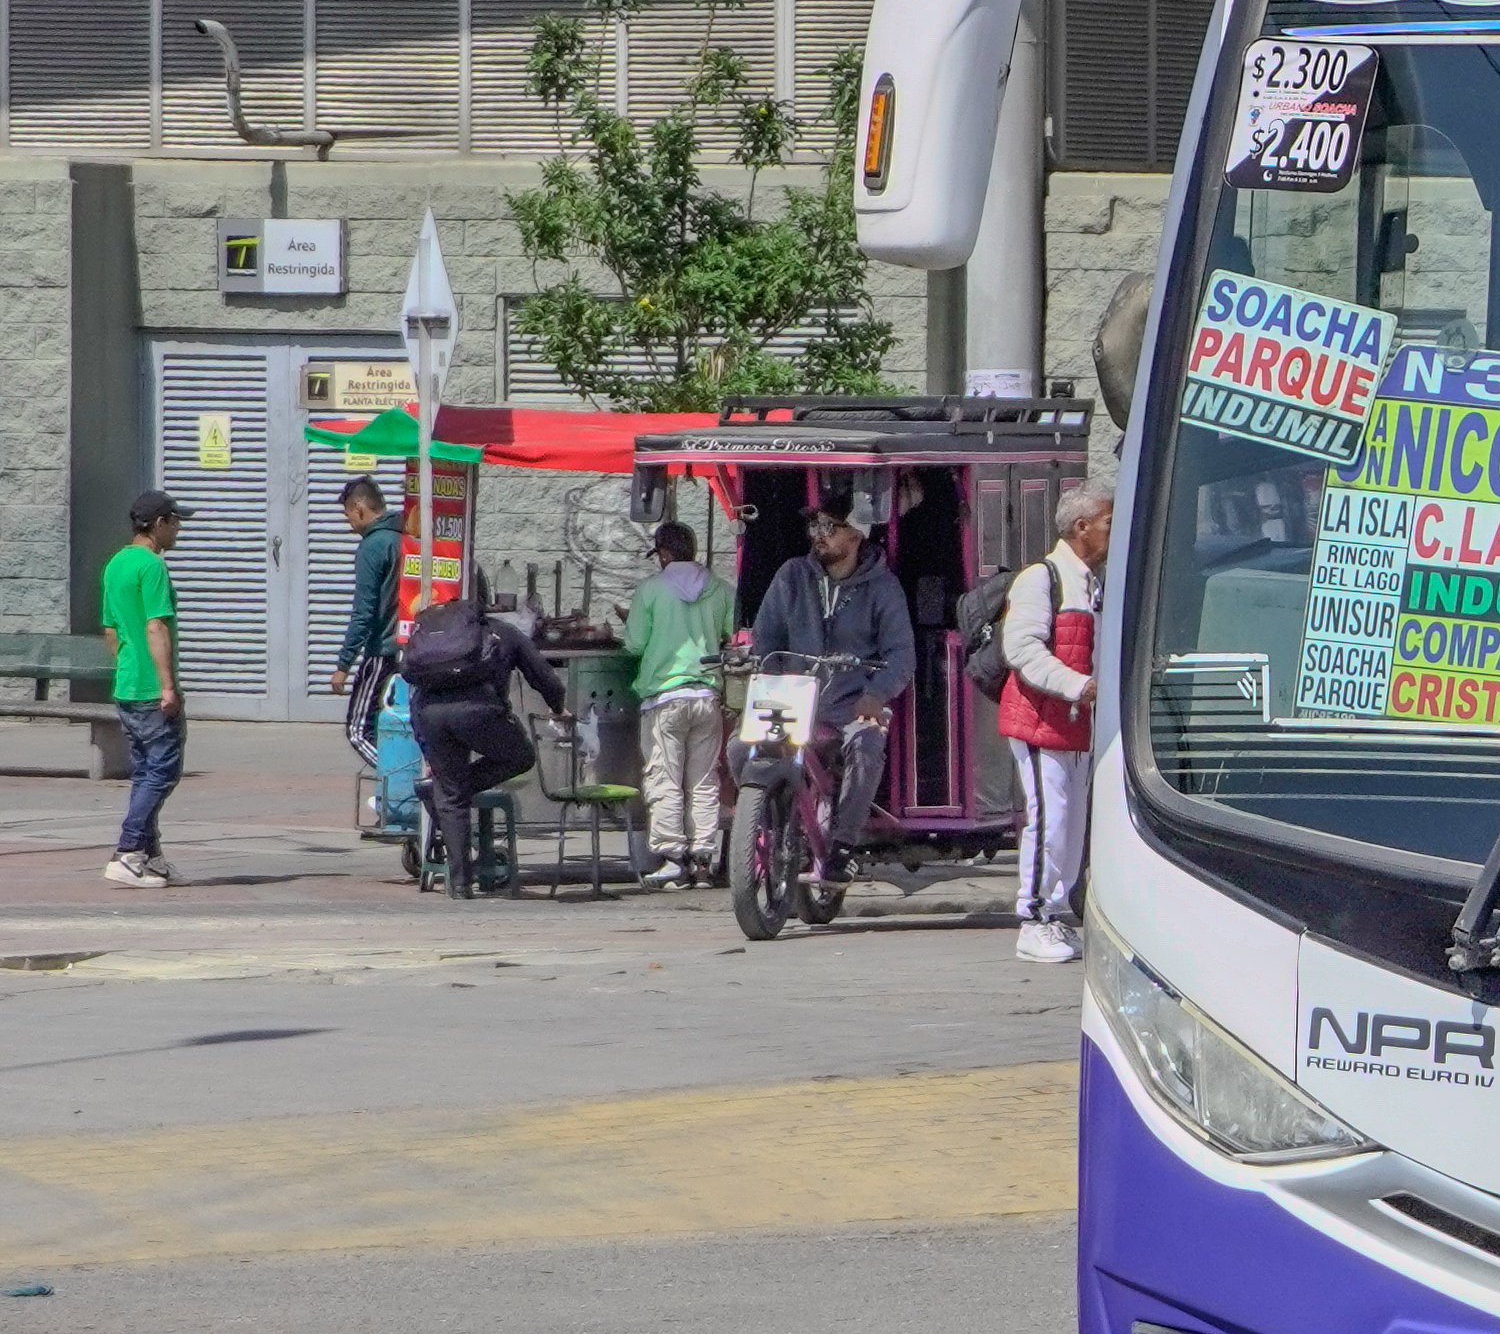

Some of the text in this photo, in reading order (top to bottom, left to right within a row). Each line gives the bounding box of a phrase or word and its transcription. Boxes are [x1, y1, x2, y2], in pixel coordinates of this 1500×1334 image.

[1252, 45, 1348, 92] $2.300
[1249, 118, 1351, 171] $2.400
[287, 237, 316, 252] Área
[267, 262, 336, 278] Restringida
[1207, 278, 1383, 366] SOACHA
[348, 379, 411, 392] Restringida
[367, 365, 392, 377] Área
[1188, 326, 1376, 417] PARQUE
[1181, 382, 1353, 458] INDUMIL
[1323, 493, 1409, 540] LA ISLA
[1327, 544, 1395, 569] RINCON
[1316, 565, 1400, 592] DEL LAGO
[1310, 595, 1396, 640] UNISUR
[1304, 643, 1387, 680] SOACHA
[1300, 674, 1386, 711] PARQUE
[1308, 1006, 1496, 1070] NPR
[1306, 1055, 1495, 1088] REWARD EURO IV
